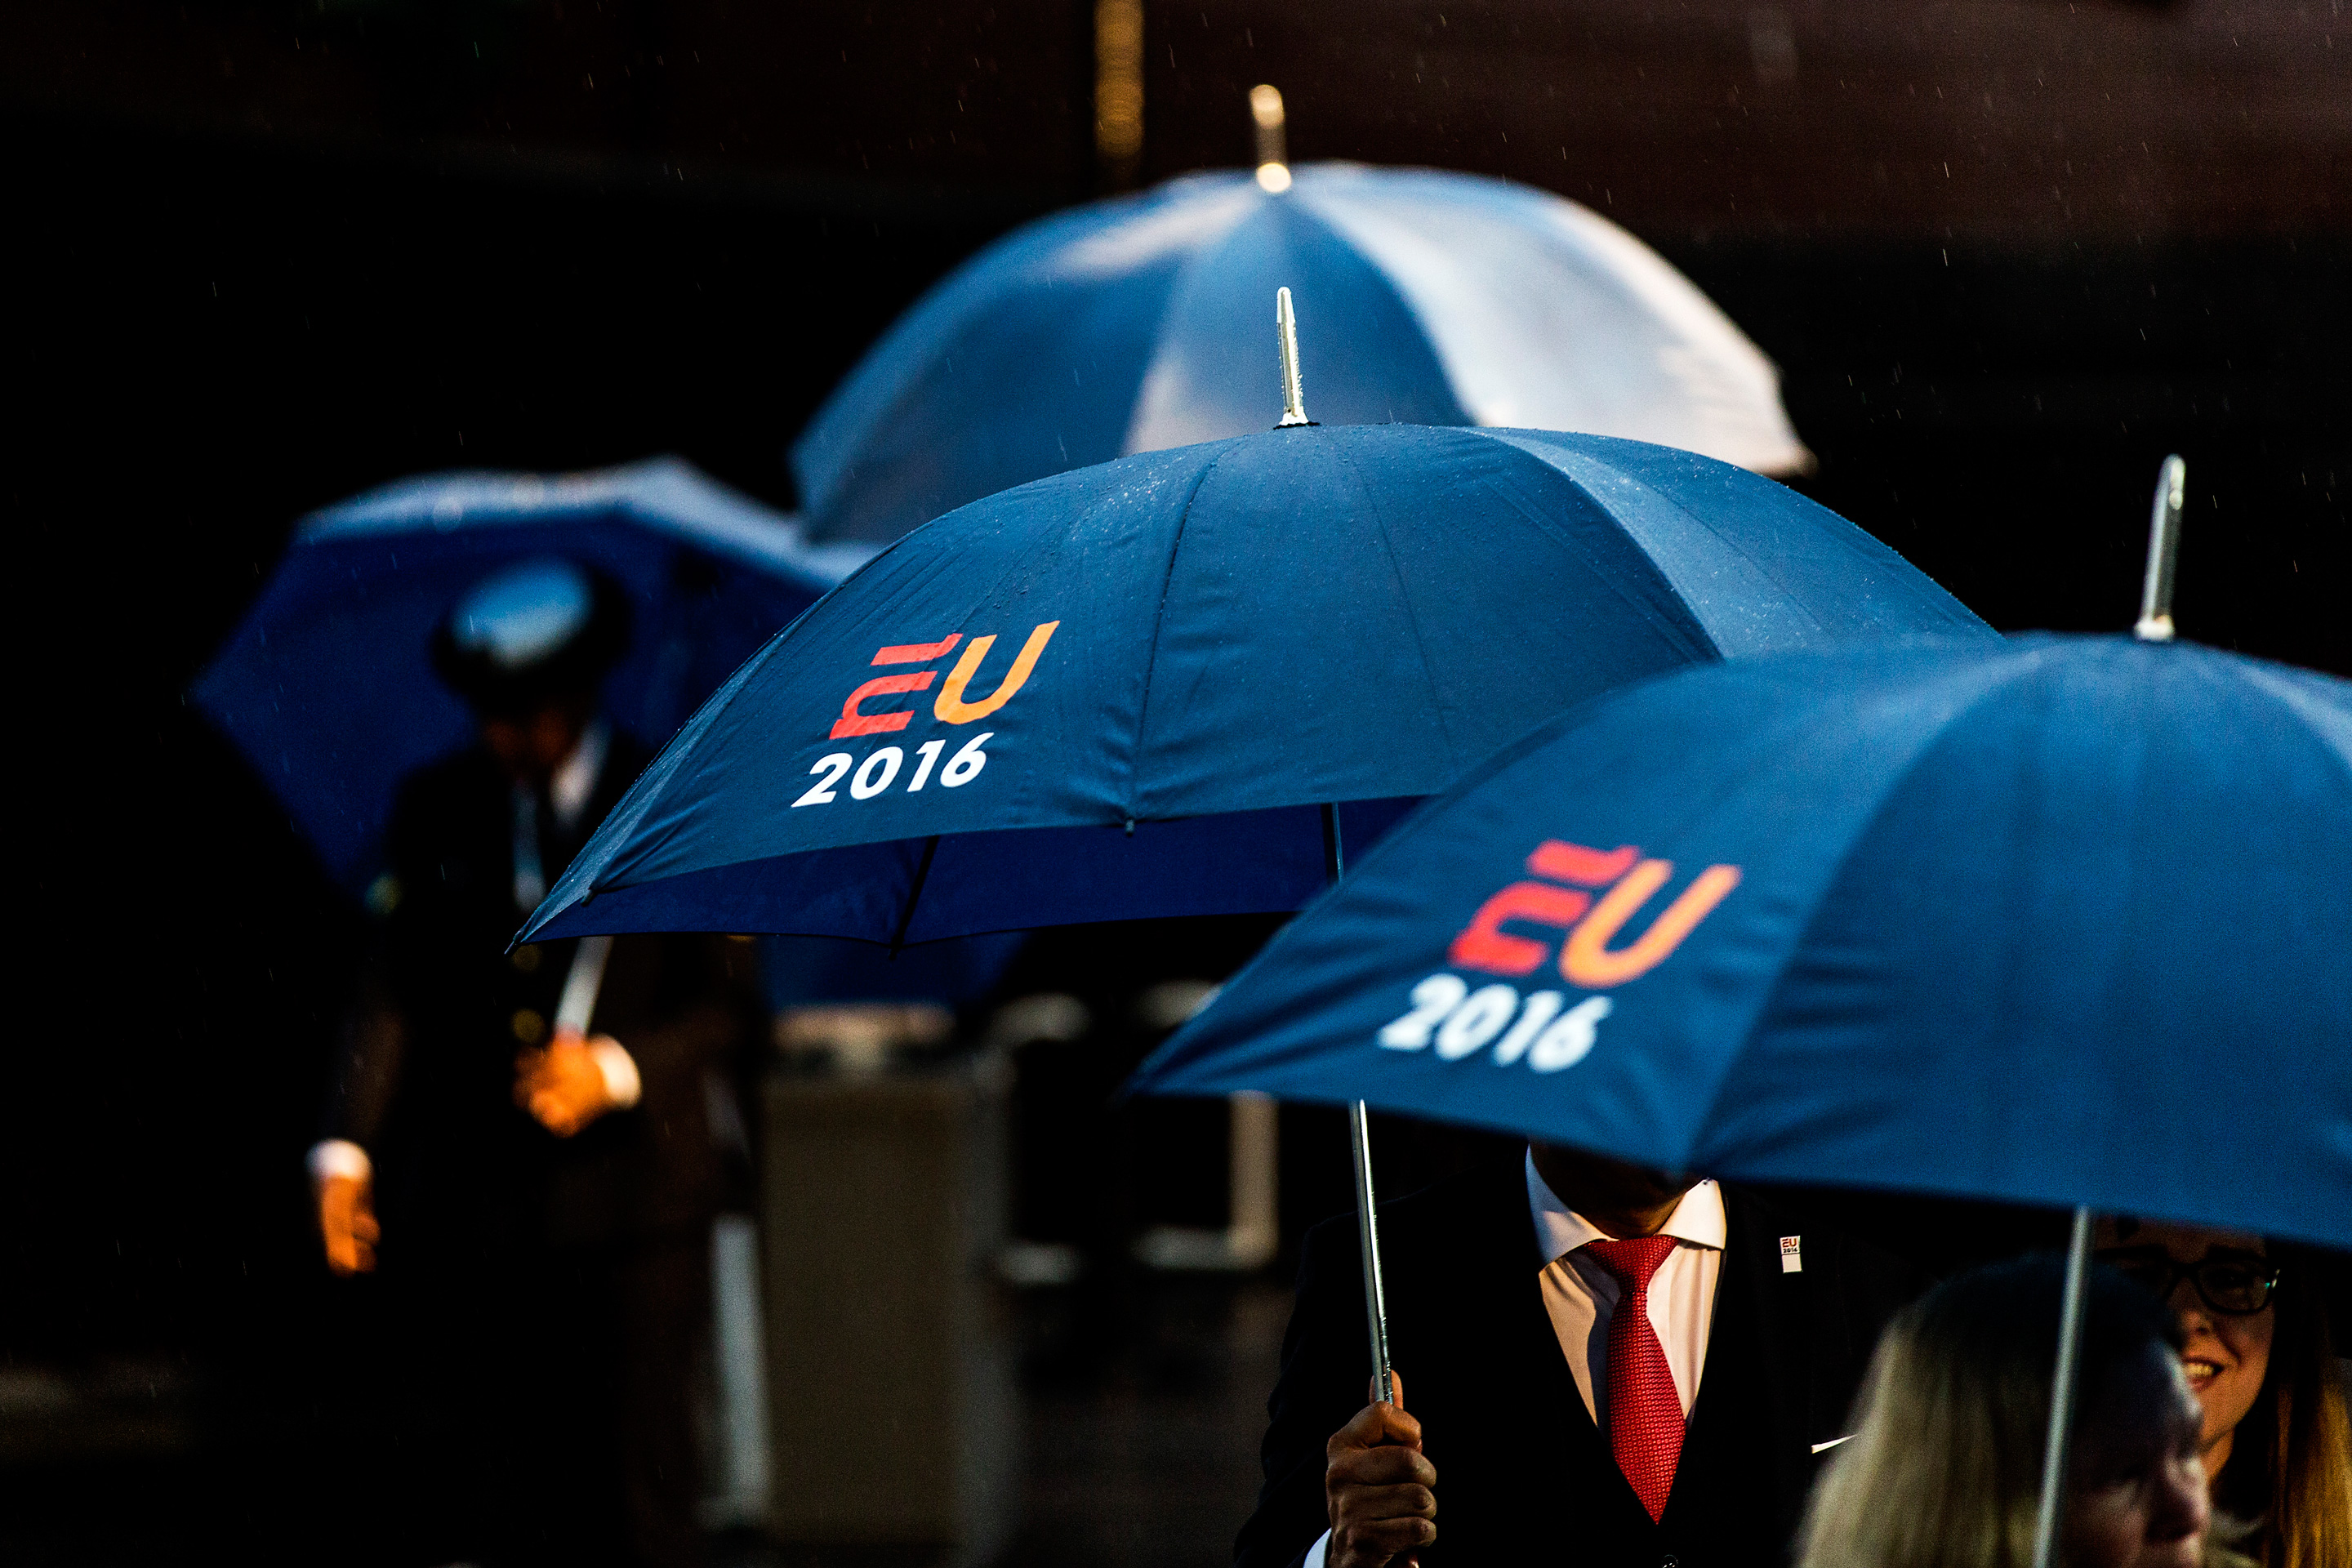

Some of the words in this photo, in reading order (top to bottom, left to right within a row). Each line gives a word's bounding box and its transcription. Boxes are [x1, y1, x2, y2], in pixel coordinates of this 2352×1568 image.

[829, 621, 1060, 739] EU
[791, 733, 994, 808] 2016
[1448, 839, 1741, 989] EU
[1378, 973, 1612, 1072] 2016
[1782, 1238, 1797, 1248] EU
